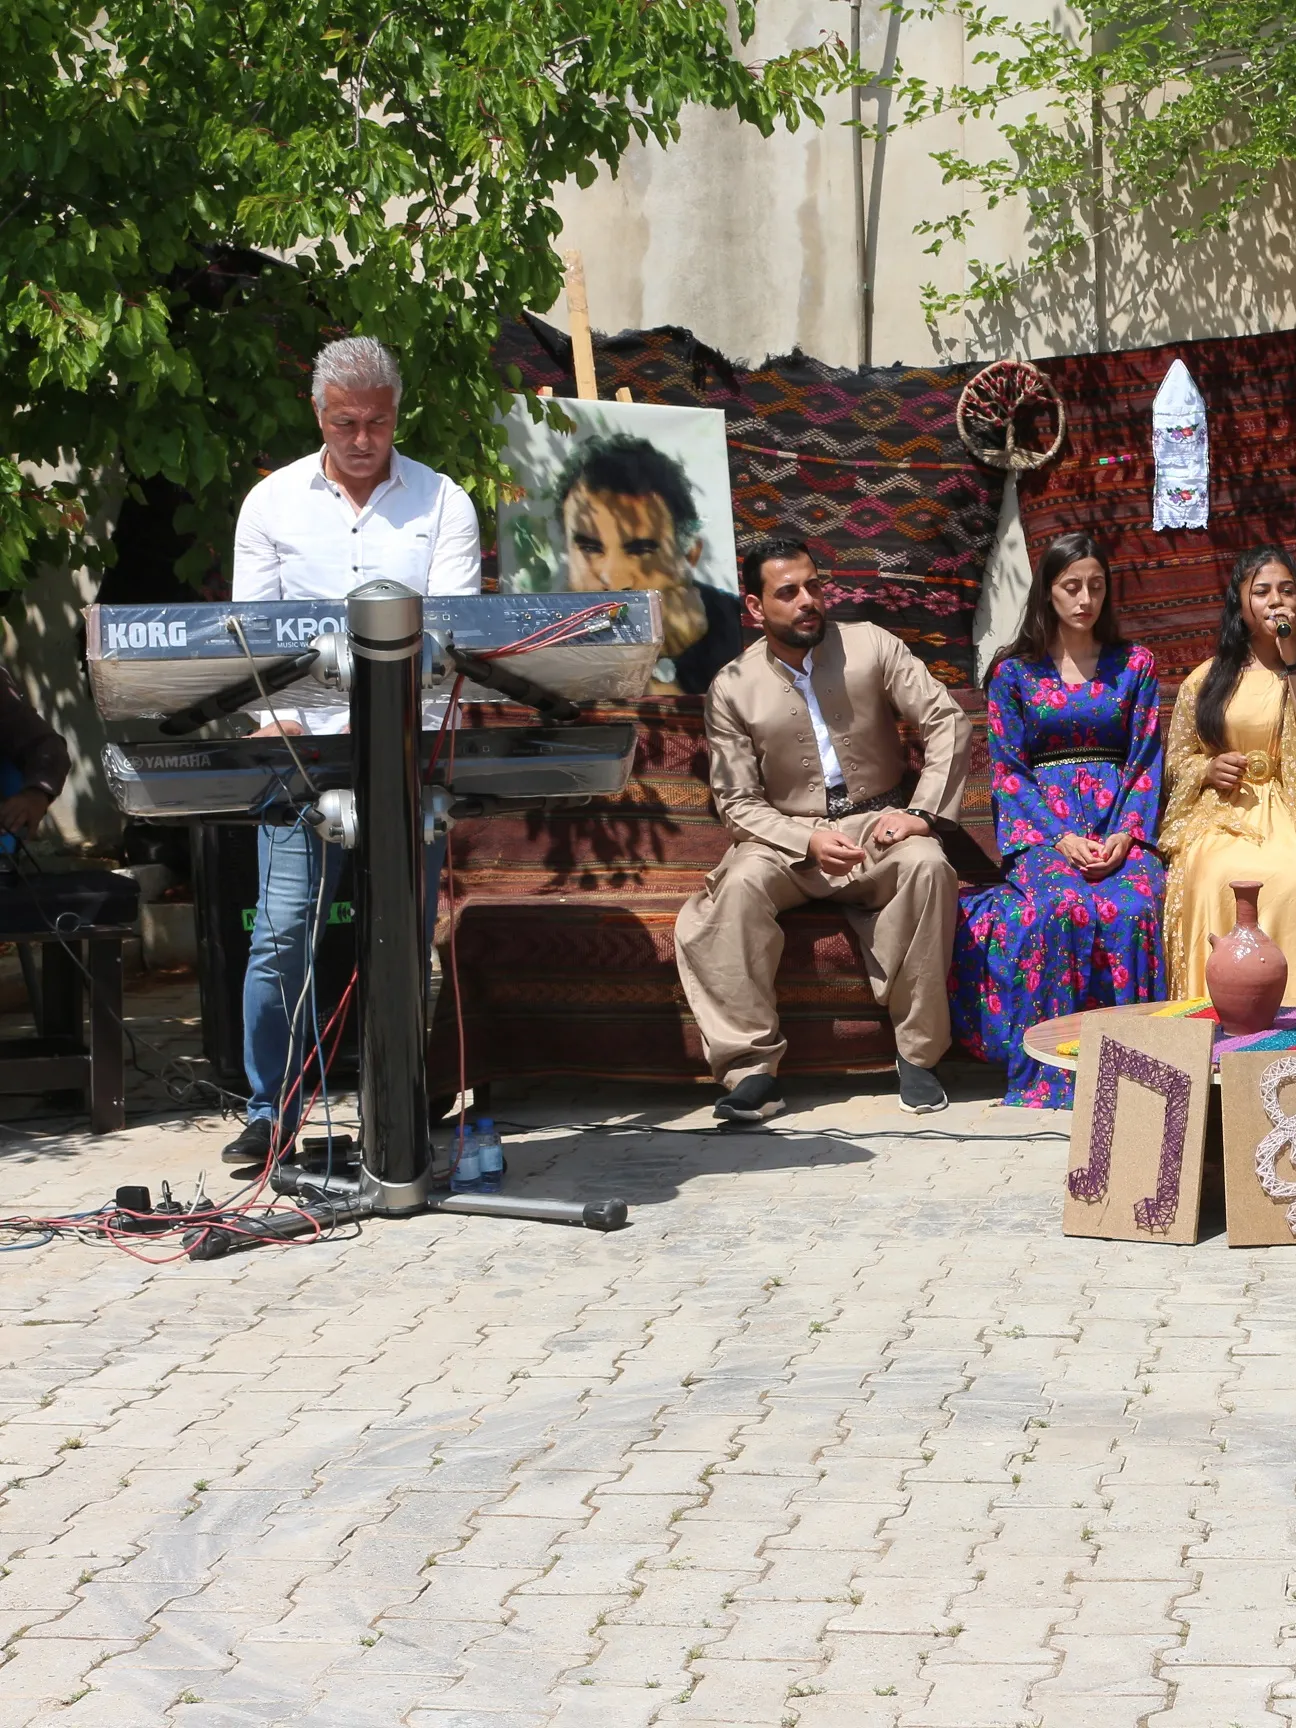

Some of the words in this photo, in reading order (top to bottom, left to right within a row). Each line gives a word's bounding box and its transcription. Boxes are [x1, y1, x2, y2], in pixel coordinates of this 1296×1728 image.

[108, 620, 188, 649] KORG
[275, 616, 346, 642] KRO
[276, 641, 299, 649] MUSIC
[144, 754, 212, 769] YAMAHA
